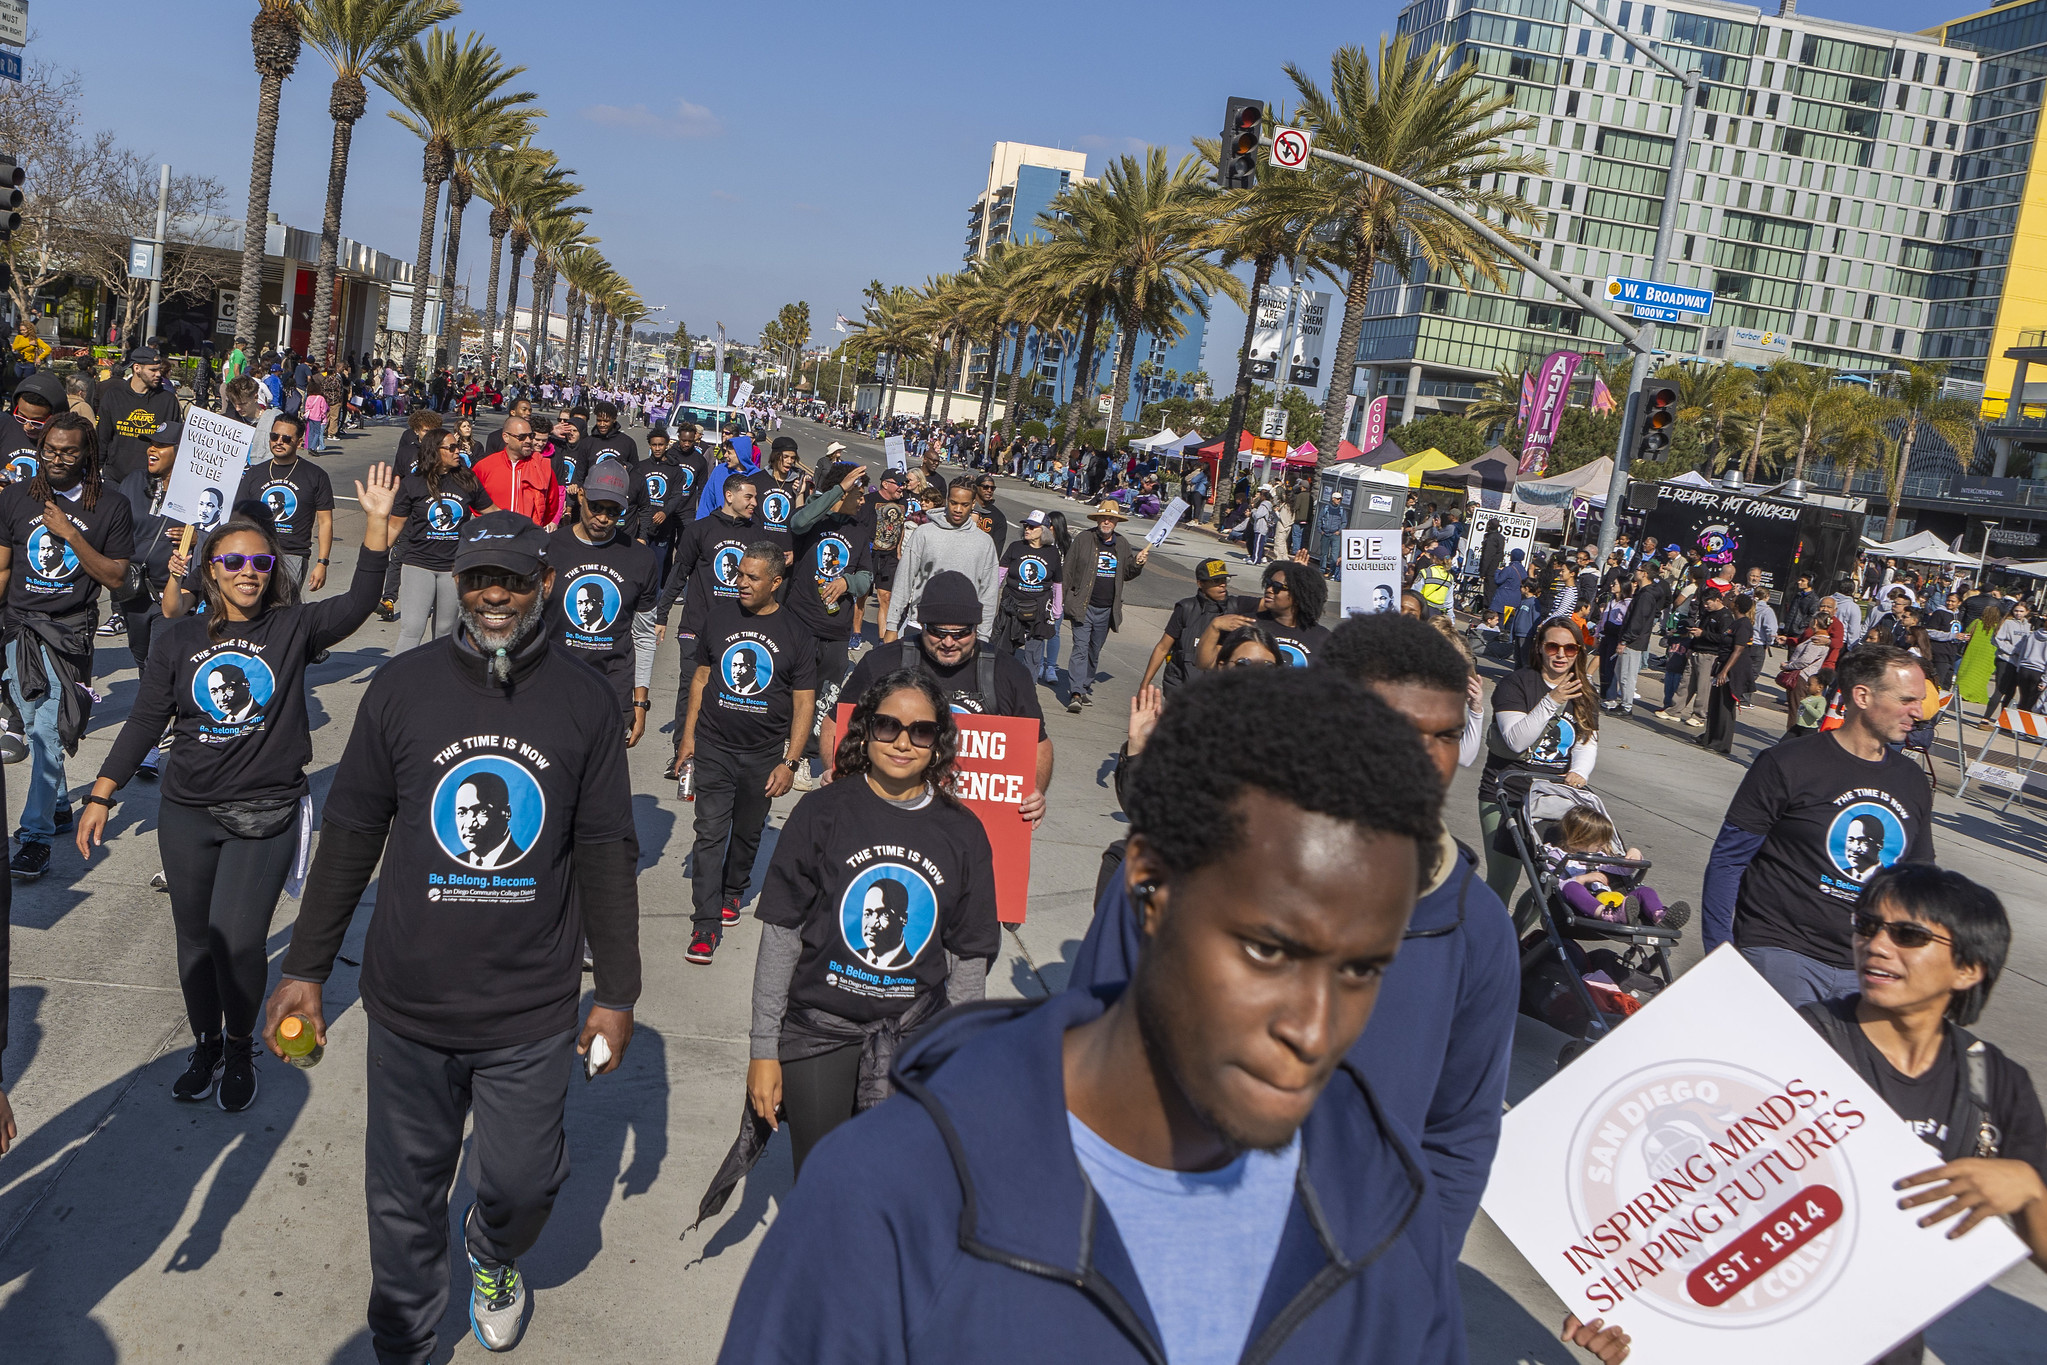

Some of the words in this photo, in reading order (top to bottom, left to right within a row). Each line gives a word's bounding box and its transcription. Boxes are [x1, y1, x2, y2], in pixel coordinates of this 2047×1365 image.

[12, 5, 24, 14] LANE
[2, 12, 18, 24] MUST
[10, 27, 22, 36] RIGHT
[8, 58, 19, 76] DR.
[1624, 283, 1640, 299] W.
[1646, 286, 1707, 309] BROADWAY
[222, 304, 234, 316] C
[1260, 298, 1286, 310] PANDAS
[1306, 304, 1324, 316] VISIT
[1264, 310, 1278, 320] ARE
[1636, 306, 1664, 318] 1000W
[1260, 319, 1278, 330] BACK
[1304, 315, 1322, 326] THEM
[1302, 326, 1321, 336] NOW
[1736, 328, 1760, 341] harbor
[1774, 334, 1787, 348] sky
[1266, 410, 1286, 418] SPEED
[1264, 424, 1283, 436] 25
[1370, 403, 1382, 450] COOK
[188, 429, 214, 449] WHO
[216, 439, 240, 458] YOU
[8, 450, 20, 458] THE
[193, 446, 228, 468] WANT
[190, 461, 204, 476] TO
[205, 469, 222, 482] BE
[1373, 497, 1392, 506] United
[1658, 486, 1672, 498] EL
[1672, 489, 1719, 510] REAPER
[1721, 496, 1752, 515] HOT
[1745, 501, 1800, 521] CHICKEN
[72, 517, 88, 532] NOW
[1510, 518, 1532, 527] DRIVE
[1476, 522, 1530, 538] CSED
[1991, 530, 2040, 542] ROTECTOR
[1346, 562, 1396, 570] CONFIDENT
[565, 567, 580, 579] THE
[608, 568, 624, 583] NOW
[574, 632, 593, 642] Belong.
[725, 632, 740, 642] THE
[766, 638, 780, 654] NOW
[190, 649, 211, 663] THE
[211, 638, 236, 652] TIME
[238, 639, 248, 648] IS
[1298, 642, 1312, 654] NOW
[726, 694, 745, 704] Belong.
[964, 699, 983, 712] NOW
[199, 724, 212, 733] Be.
[433, 742, 462, 766] THE
[463, 735, 500, 750] TIME
[503, 737, 518, 750] IS
[519, 743, 550, 770] NOW
[1833, 791, 1855, 806] THE
[1854, 788, 1880, 798] TIME
[1880, 792, 1890, 802] IS
[1890, 798, 1910, 820] NOW
[846, 850, 872, 868] THE
[874, 846, 904, 858] TIME
[908, 850, 921, 863] IS
[924, 858, 944, 886] NOW
[428, 873, 446, 884] Be.
[448, 874, 490, 888] Belong.
[492, 876, 536, 886] Become.
[1820, 874, 1834, 886] Be.
[453, 888, 469, 896] Diego
[470, 888, 499, 897] Community
[828, 960, 844, 974] Be.
[845, 964, 881, 985] Belong.
[1589, 1120, 1628, 1184] SAN
[1618, 1080, 1720, 1126] DIEGO
[1562, 1154, 1716, 1276] INSPIRING
[1708, 1079, 1830, 1167] MINDS,
[1586, 1204, 1724, 1312] SHAPING
[1714, 1100, 1866, 1217] FUTURES
[1703, 1250, 1762, 1293] EST.
[1761, 1199, 1826, 1252] 1914
